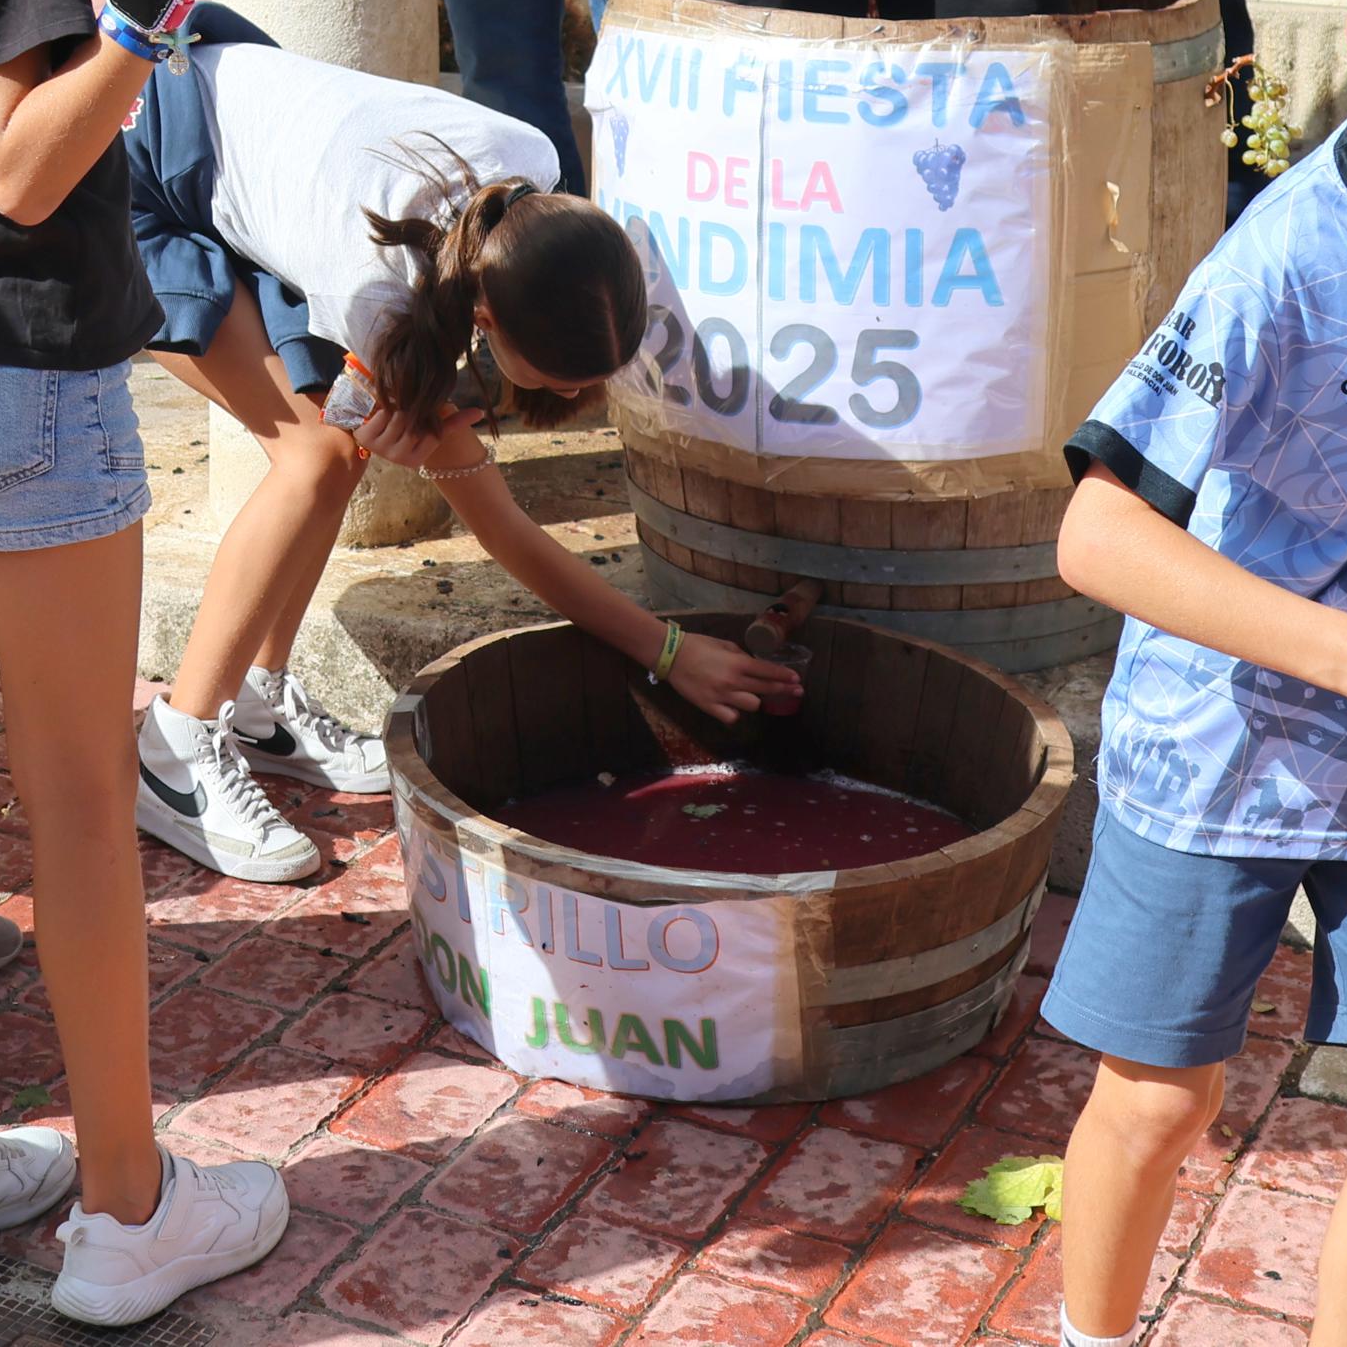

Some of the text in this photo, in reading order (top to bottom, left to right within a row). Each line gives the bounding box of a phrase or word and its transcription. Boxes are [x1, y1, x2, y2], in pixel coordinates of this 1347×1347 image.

[605, 35, 1029, 129] XVII FIESTA
[686, 151, 845, 214] DE LA
[645, 304, 923, 430] 2025
[523, 997, 719, 1071] JUAN
